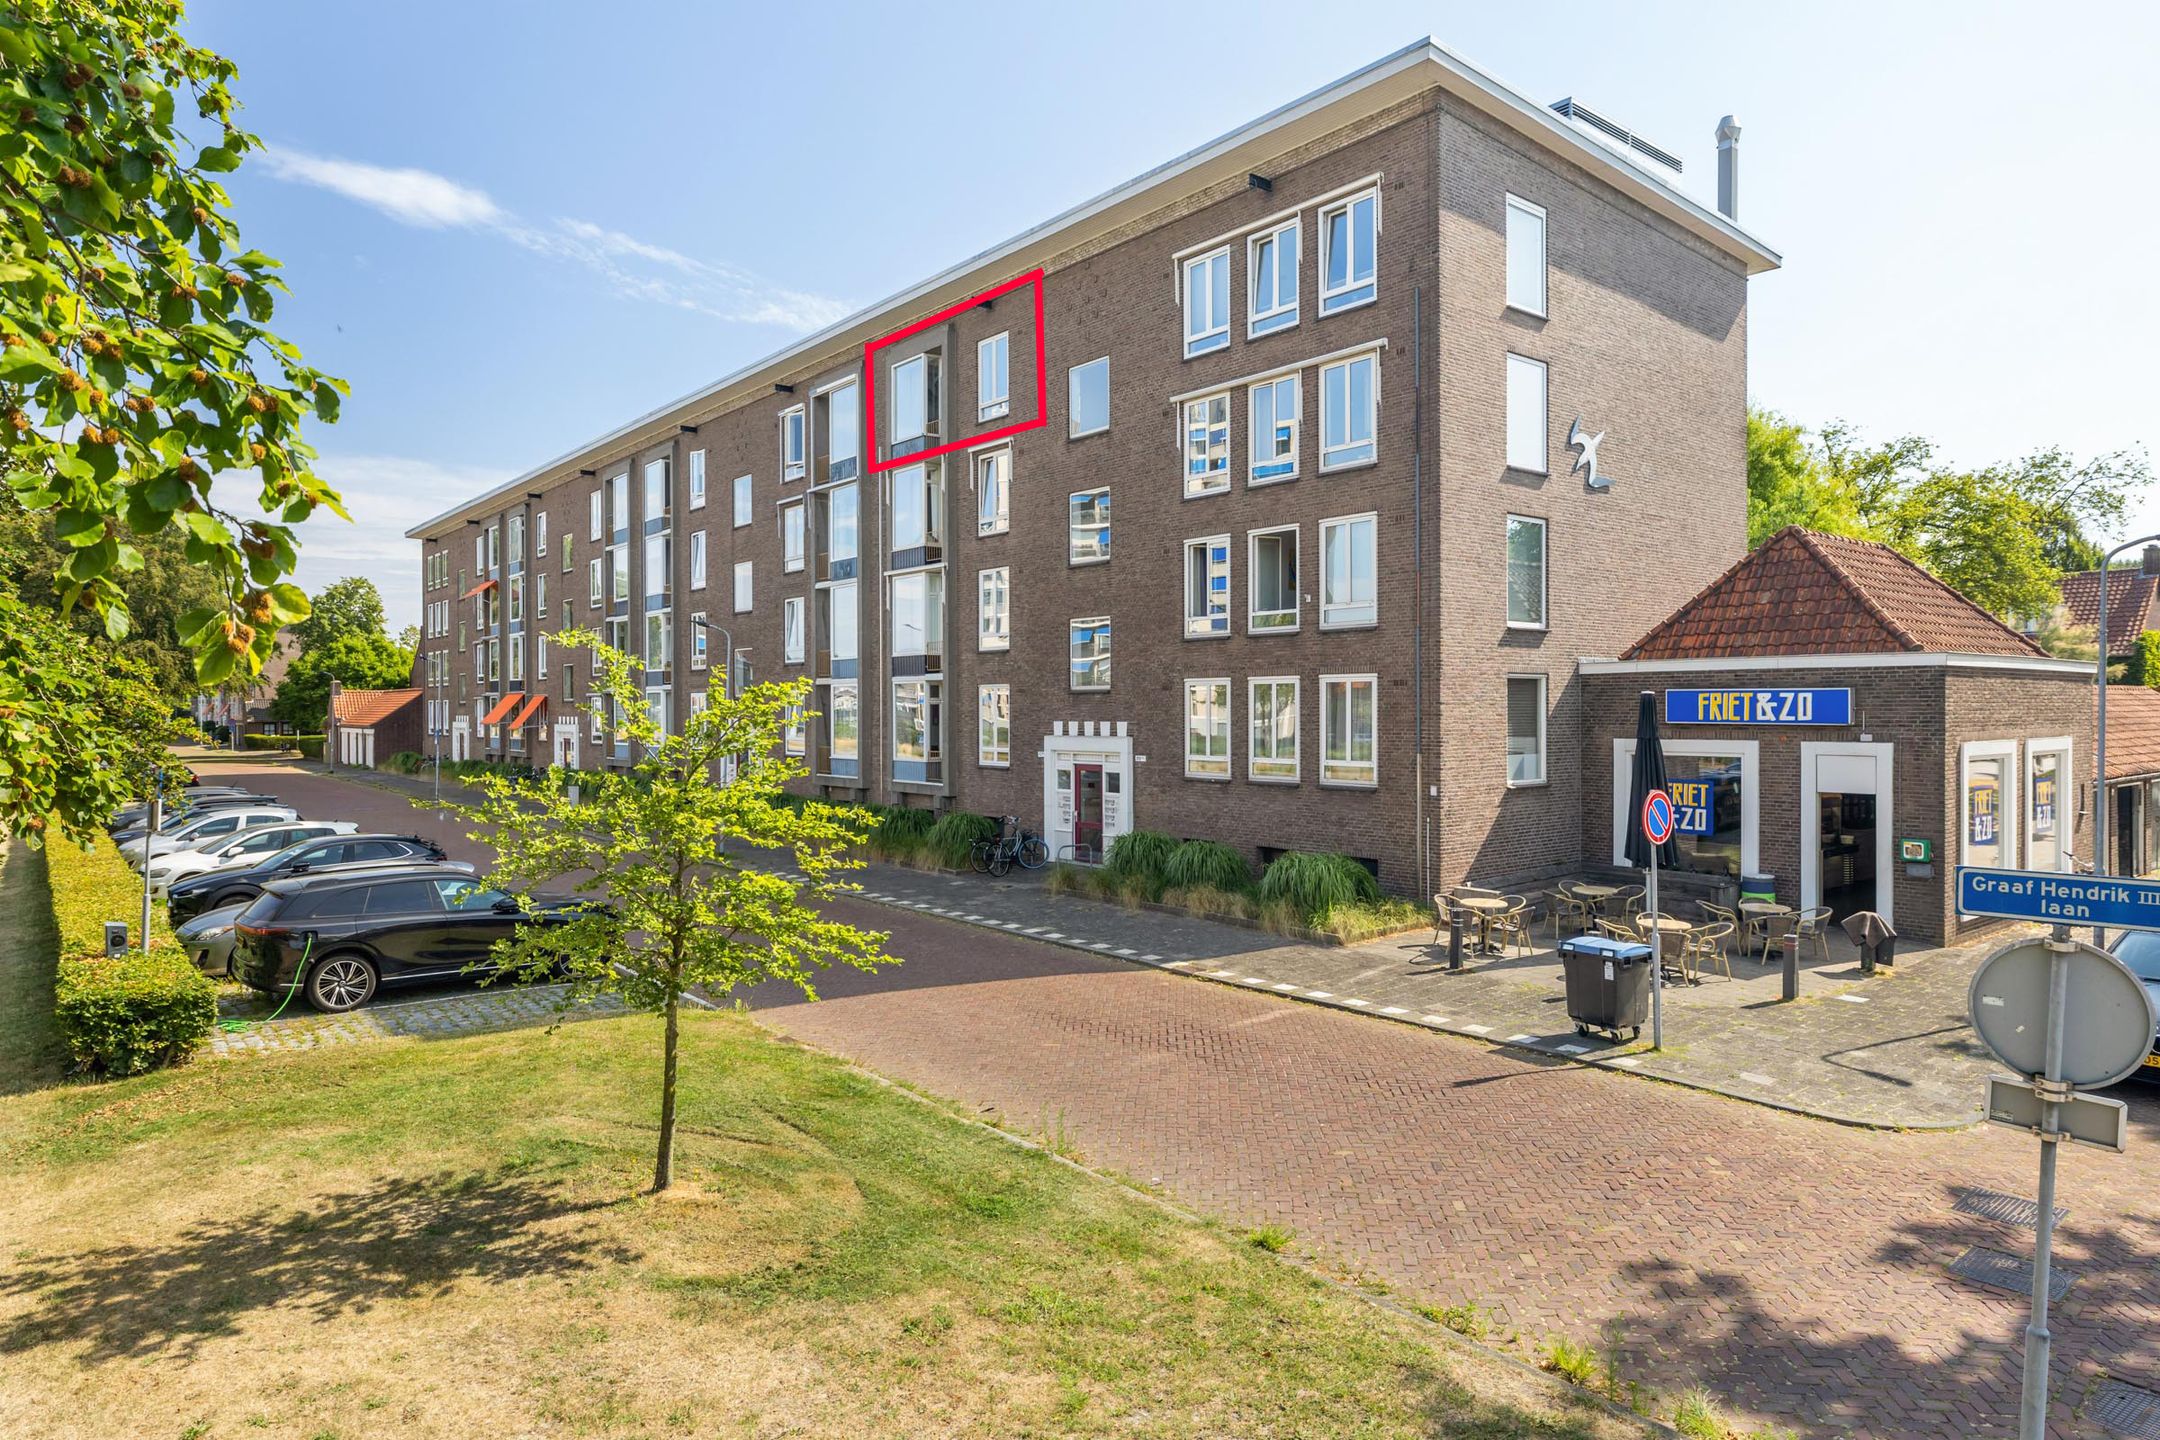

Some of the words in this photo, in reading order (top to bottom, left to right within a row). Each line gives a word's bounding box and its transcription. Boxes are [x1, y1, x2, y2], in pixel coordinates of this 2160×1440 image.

[1972, 876, 2034, 895] Graaf
[2040, 881, 2130, 903] Hendrik
[2041, 899, 2090, 918] laan
